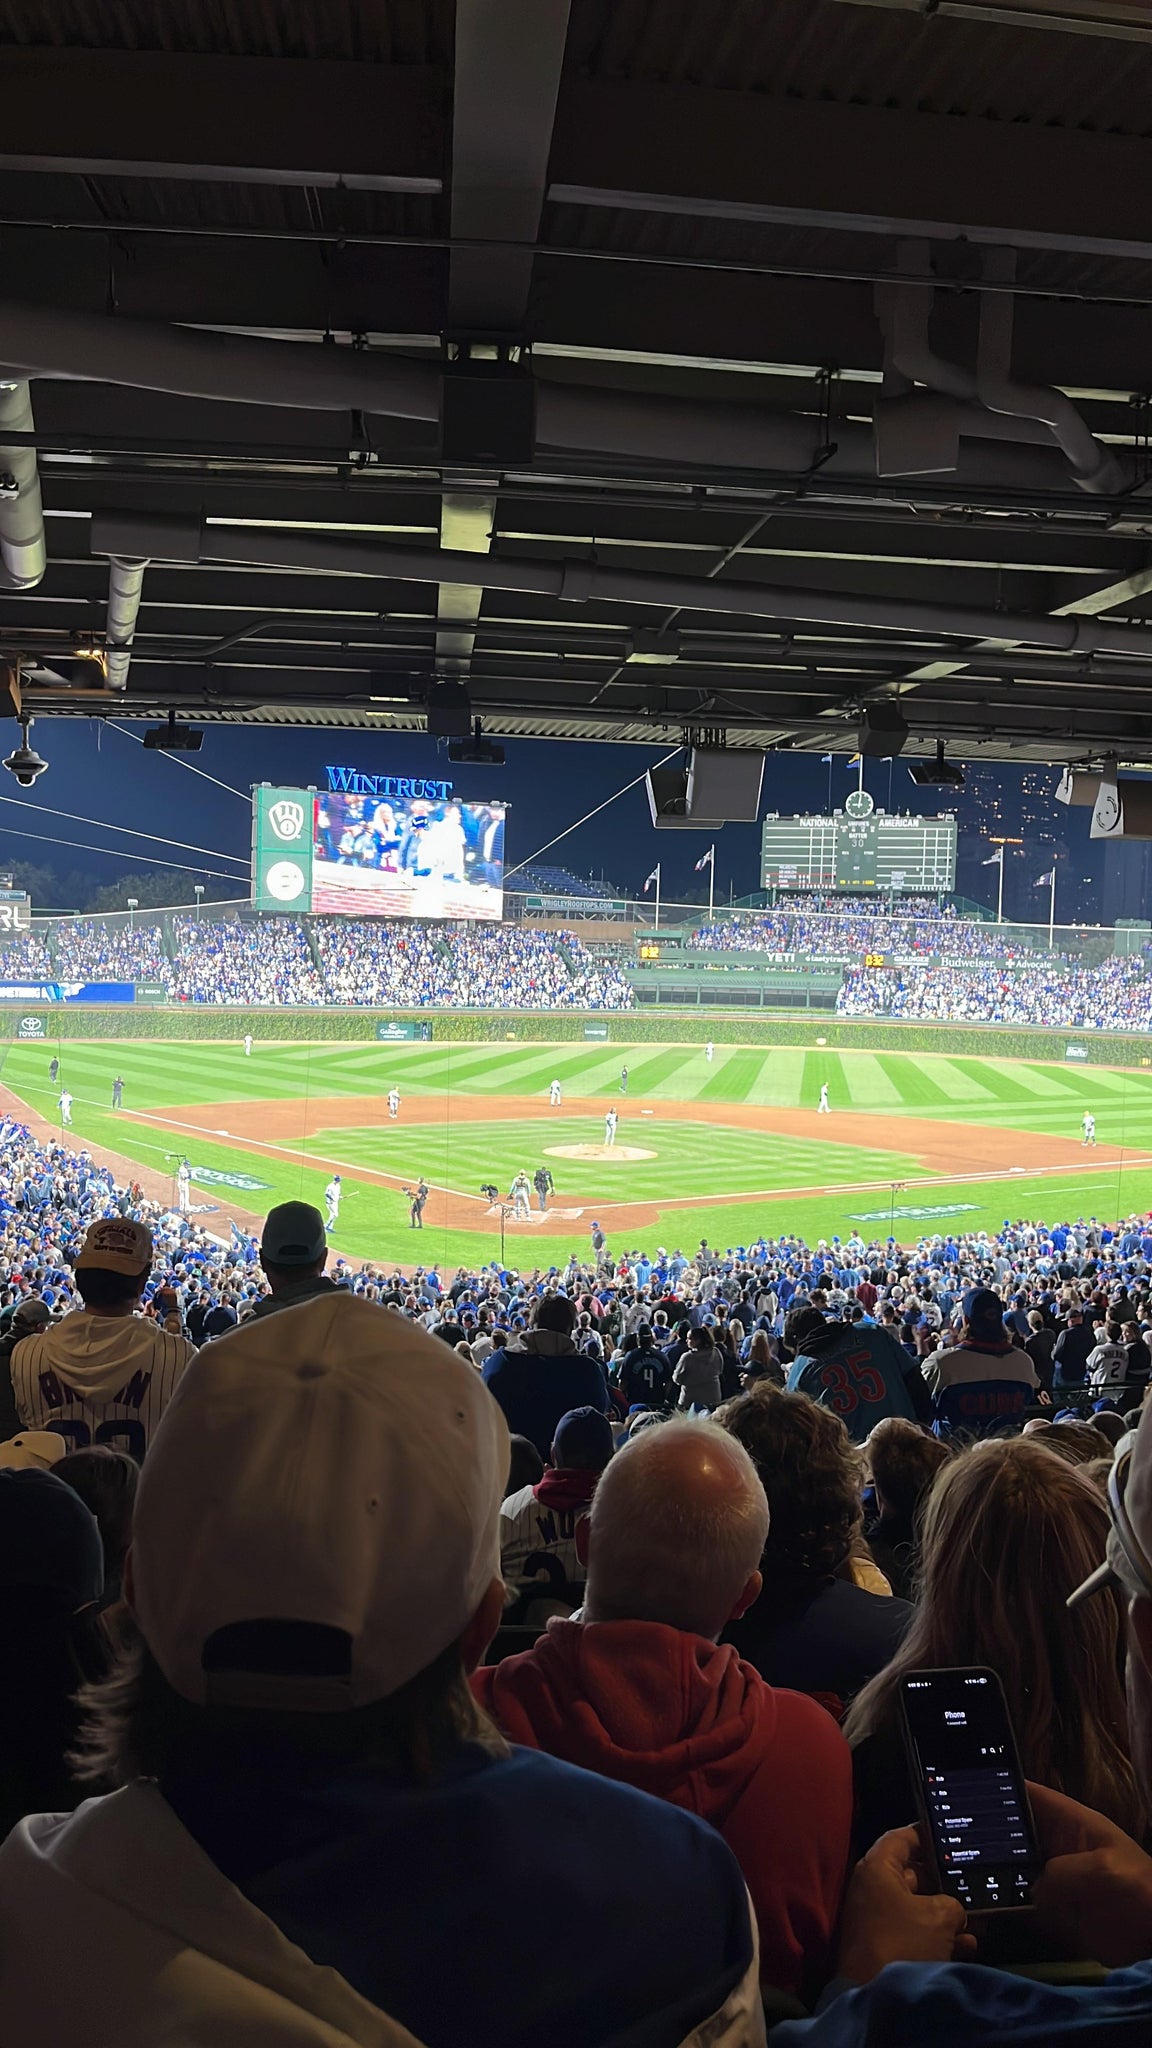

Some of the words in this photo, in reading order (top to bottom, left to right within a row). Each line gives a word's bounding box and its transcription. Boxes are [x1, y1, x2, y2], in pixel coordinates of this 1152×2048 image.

[326, 766, 453, 800] WINTRUST
[799, 818, 839, 827] NATIONAL
[878, 819, 920, 827] AMERICAN
[851, 839, 864, 847] 30
[766, 953, 795, 963] YETI
[811, 955, 851, 964] tastytrade
[940, 957, 995, 968] Budweiser
[1016, 961, 1053, 969] Advocate
[1110, 1360, 1121, 1378] 2
[643, 1368, 654, 1389] 4
[821, 1350, 887, 1415] 35
